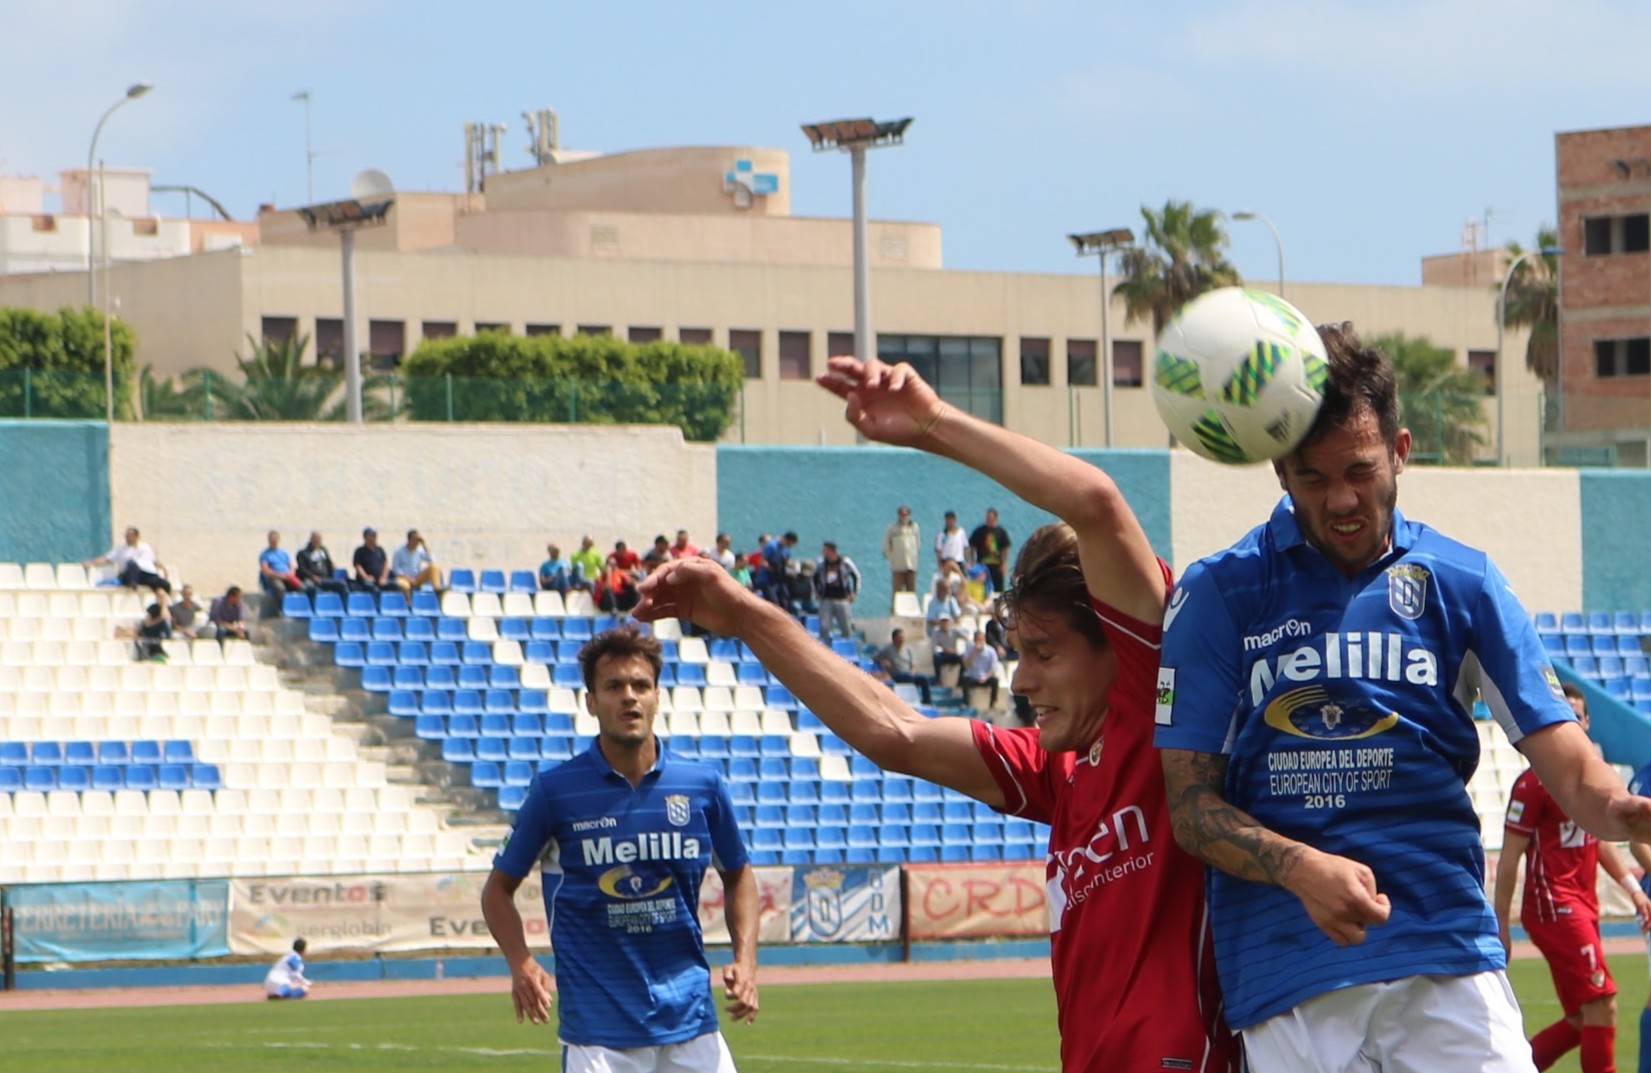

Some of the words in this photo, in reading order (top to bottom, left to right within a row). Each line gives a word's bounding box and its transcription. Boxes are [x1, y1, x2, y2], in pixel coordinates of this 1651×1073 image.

[1244, 619, 1312, 651] macron
[1250, 632, 1438, 707] Melilla
[1268, 750, 1299, 771] CIUDAD
[1300, 749, 1338, 770] EUROPEA
[1339, 749, 1355, 769] DEL
[1356, 748, 1394, 768] DEPORTE
[1270, 772, 1321, 796] EUROPEAN
[1322, 771, 1344, 793] CITY
[1345, 771, 1359, 793] OF
[1361, 769, 1393, 791] SPORT
[1304, 795, 1346, 809] 2016
[582, 832, 700, 866] Melilla
[1093, 852, 1154, 887] nterior
[249, 881, 388, 903] Eventos
[1581, 943, 1598, 970] 7
